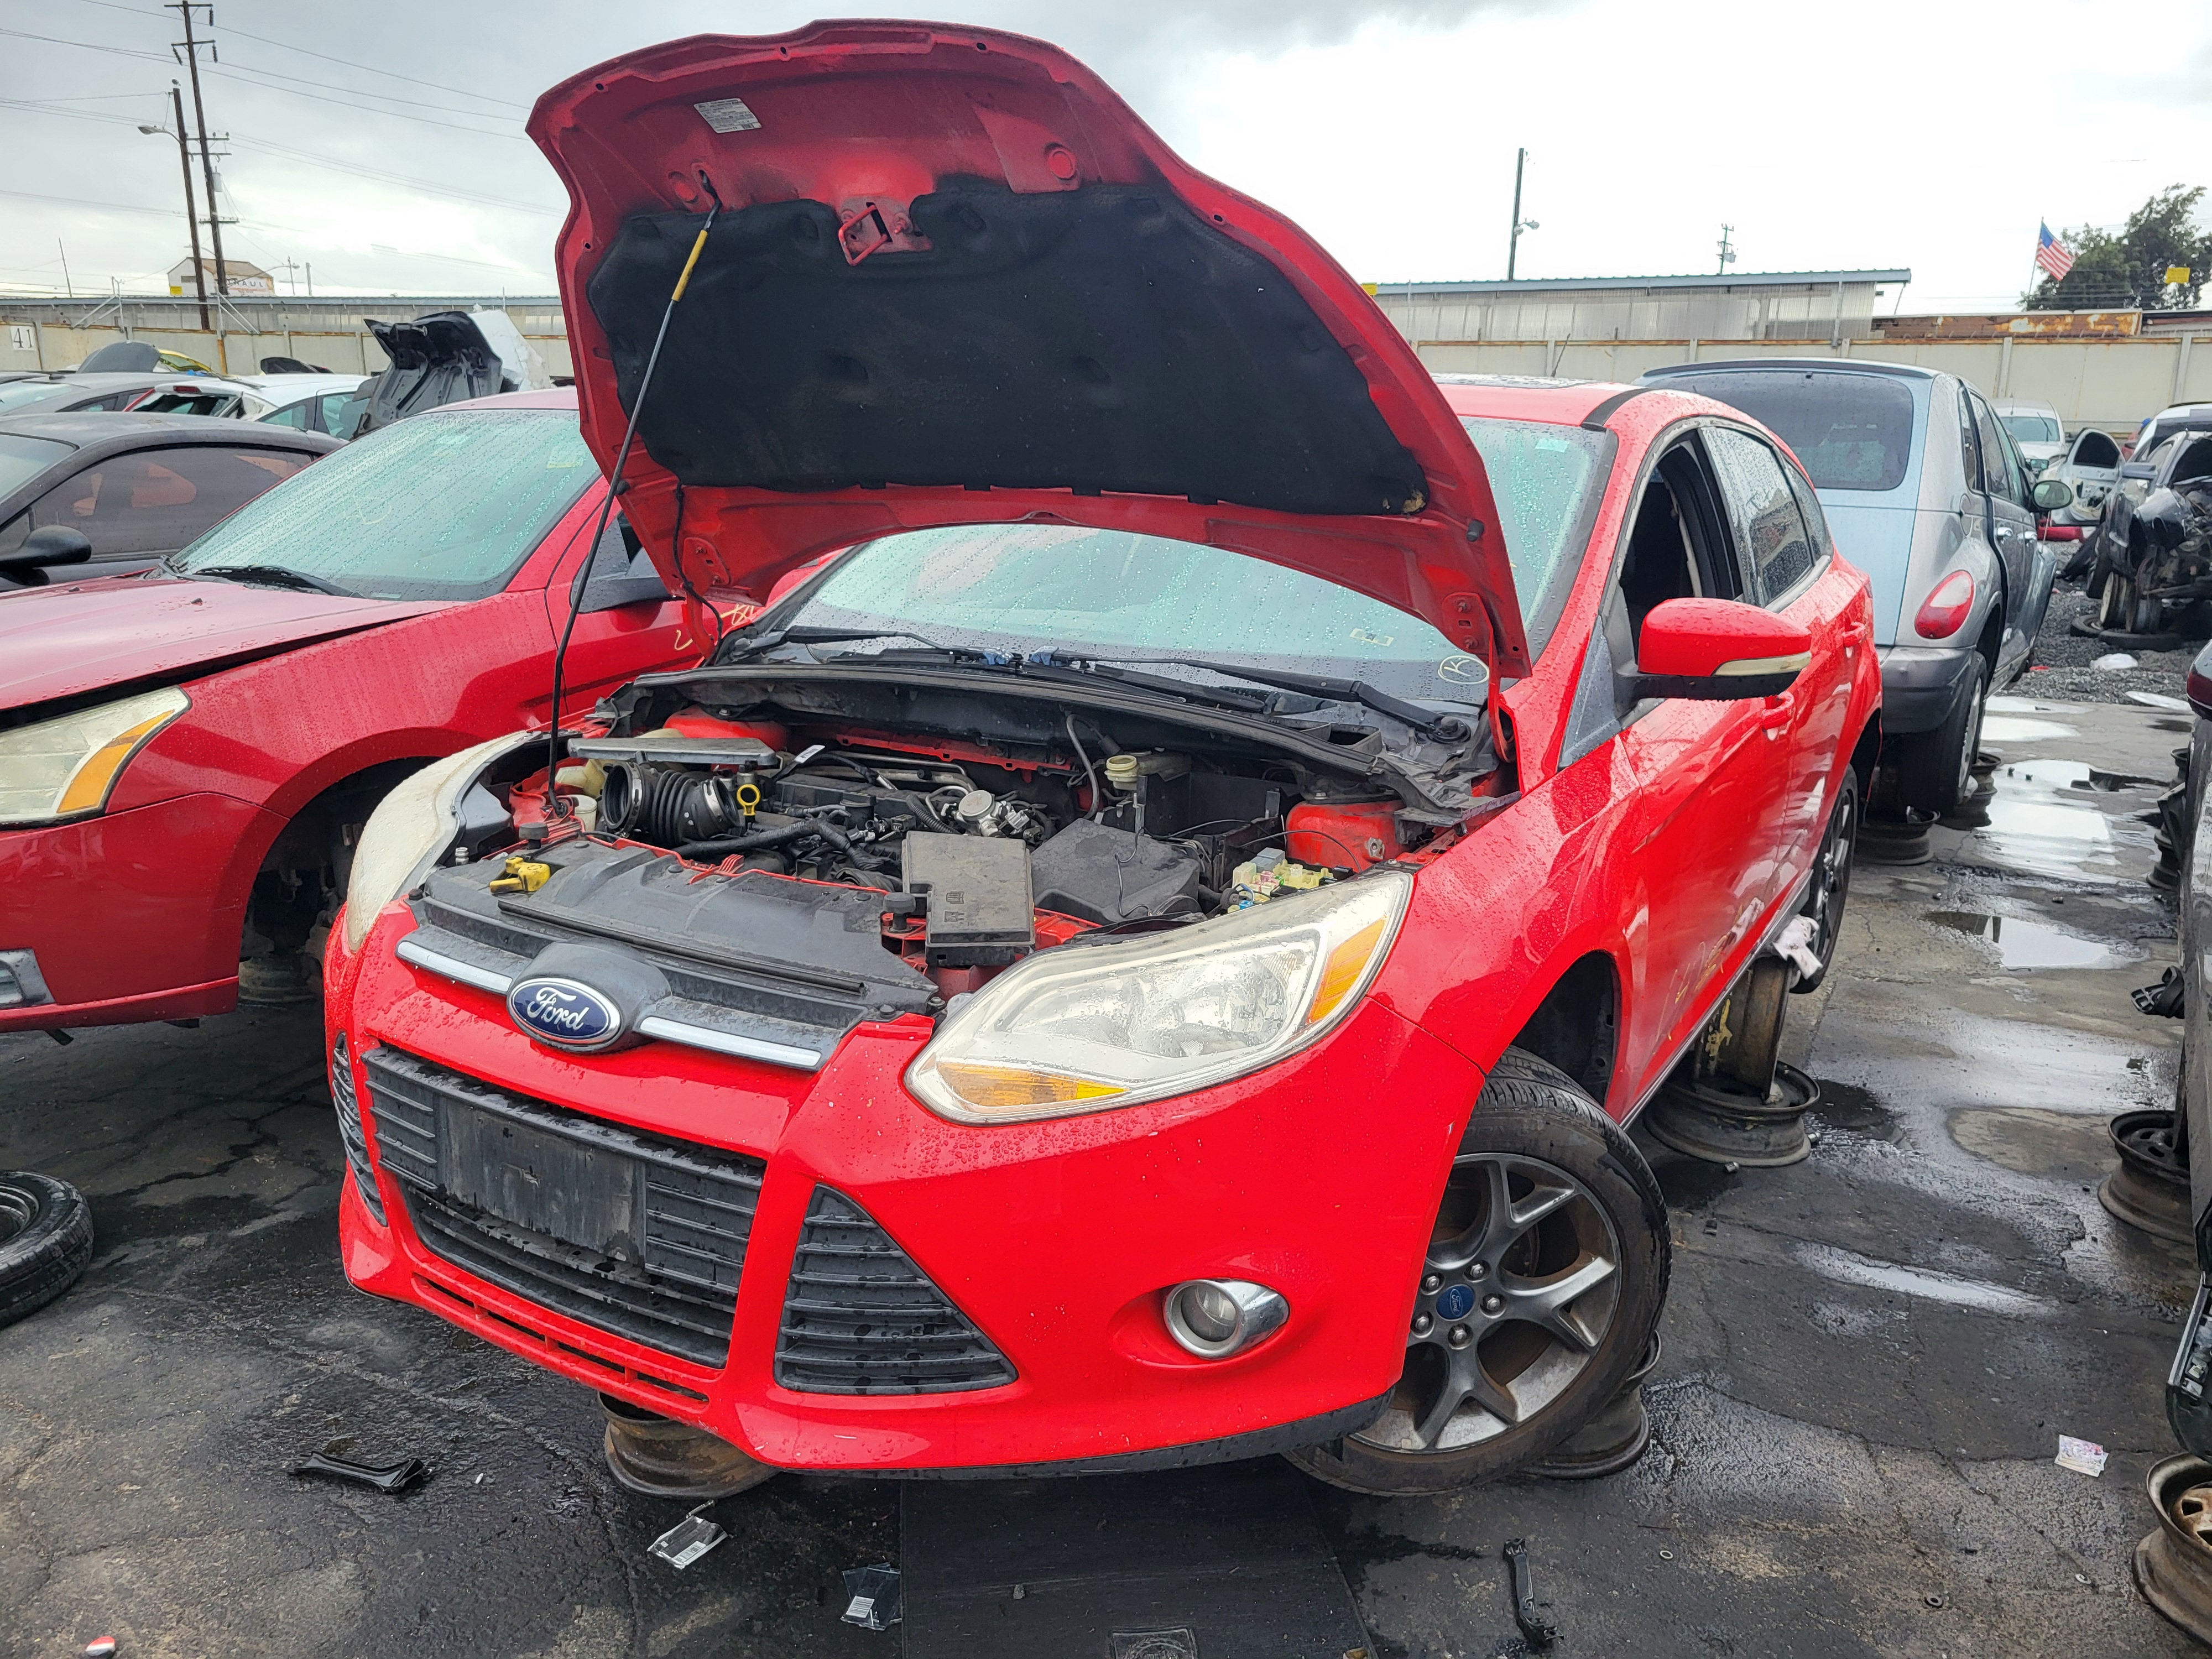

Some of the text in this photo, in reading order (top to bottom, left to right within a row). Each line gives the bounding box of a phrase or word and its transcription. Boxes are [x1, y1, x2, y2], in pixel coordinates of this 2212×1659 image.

[13, 327, 33, 349] 41
[526, 987, 590, 1031] Ford
[1451, 1294, 1461, 1313] Ford
